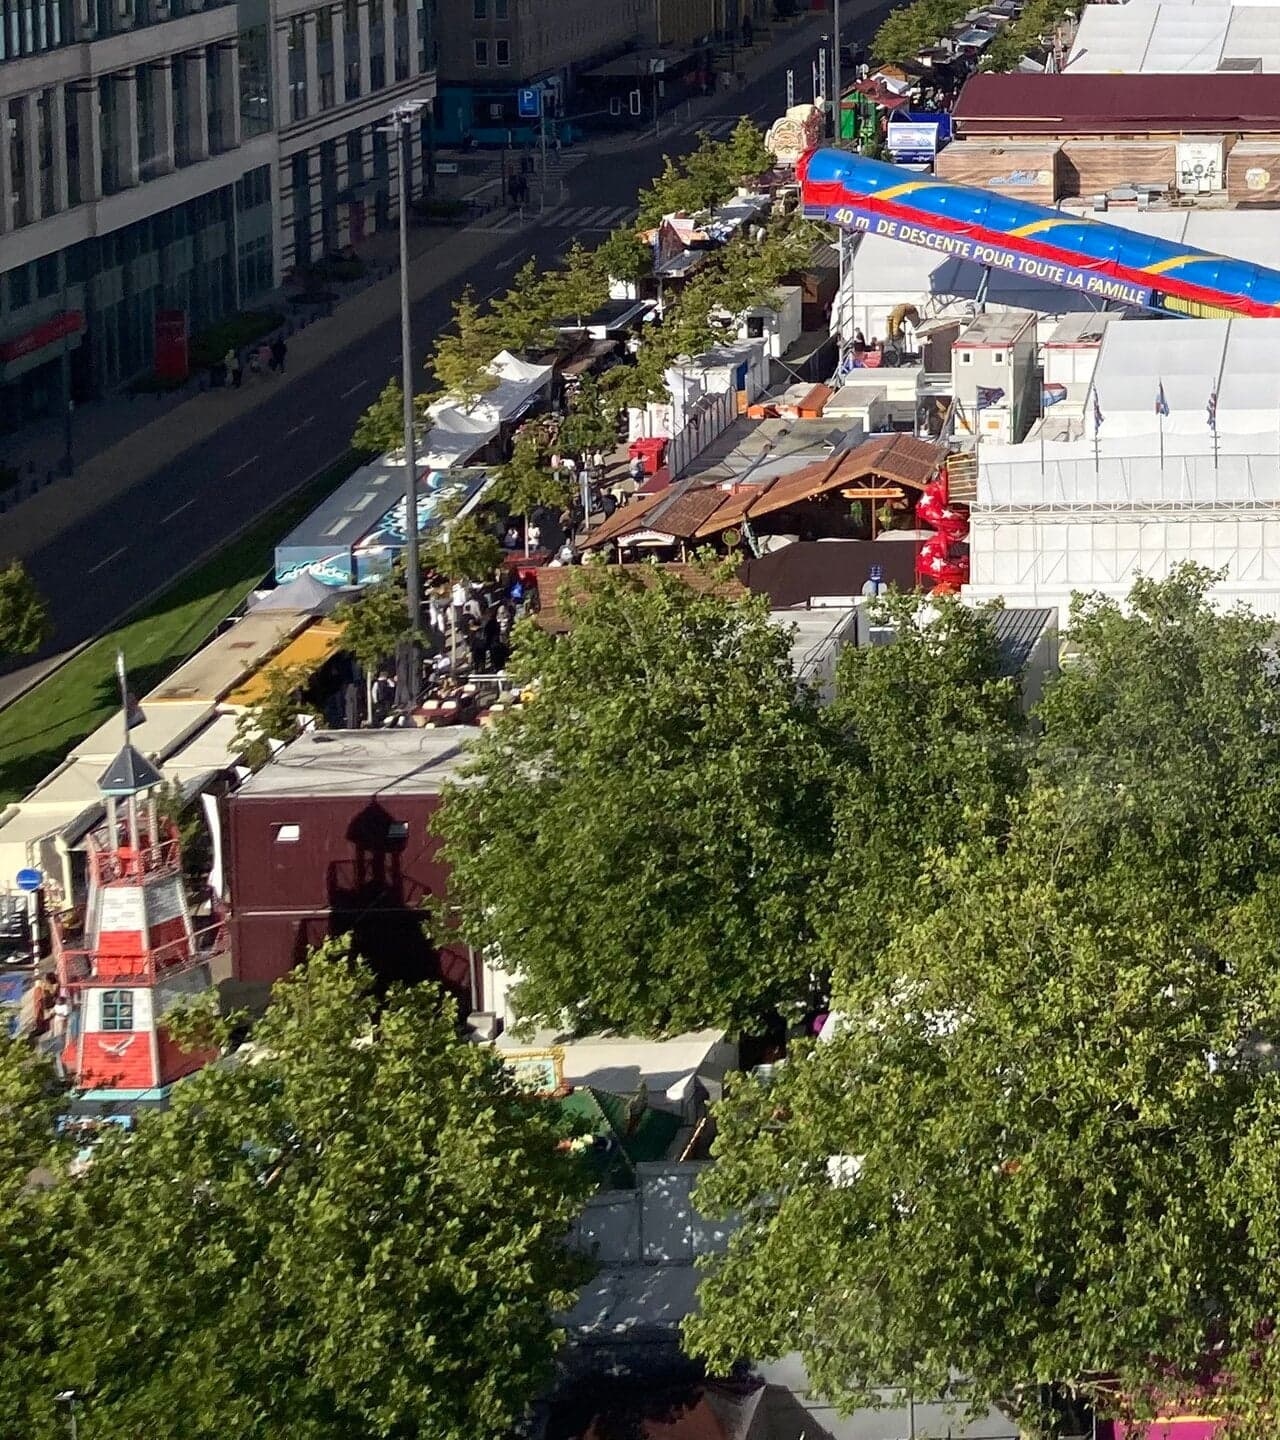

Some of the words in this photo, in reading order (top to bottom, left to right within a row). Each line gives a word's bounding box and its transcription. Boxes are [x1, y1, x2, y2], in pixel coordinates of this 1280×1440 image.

[524, 91, 533, 103] P
[834, 208, 853, 224] 40
[856, 217, 869, 230] m
[877, 219, 897, 236] DE
[899, 226, 970, 257] DESCENTE
[974, 246, 1014, 269] POUR
[1018, 258, 1064, 282] TOUTE
[1066, 272, 1083, 288] LA
[1087, 277, 1146, 305] FAMILLE
